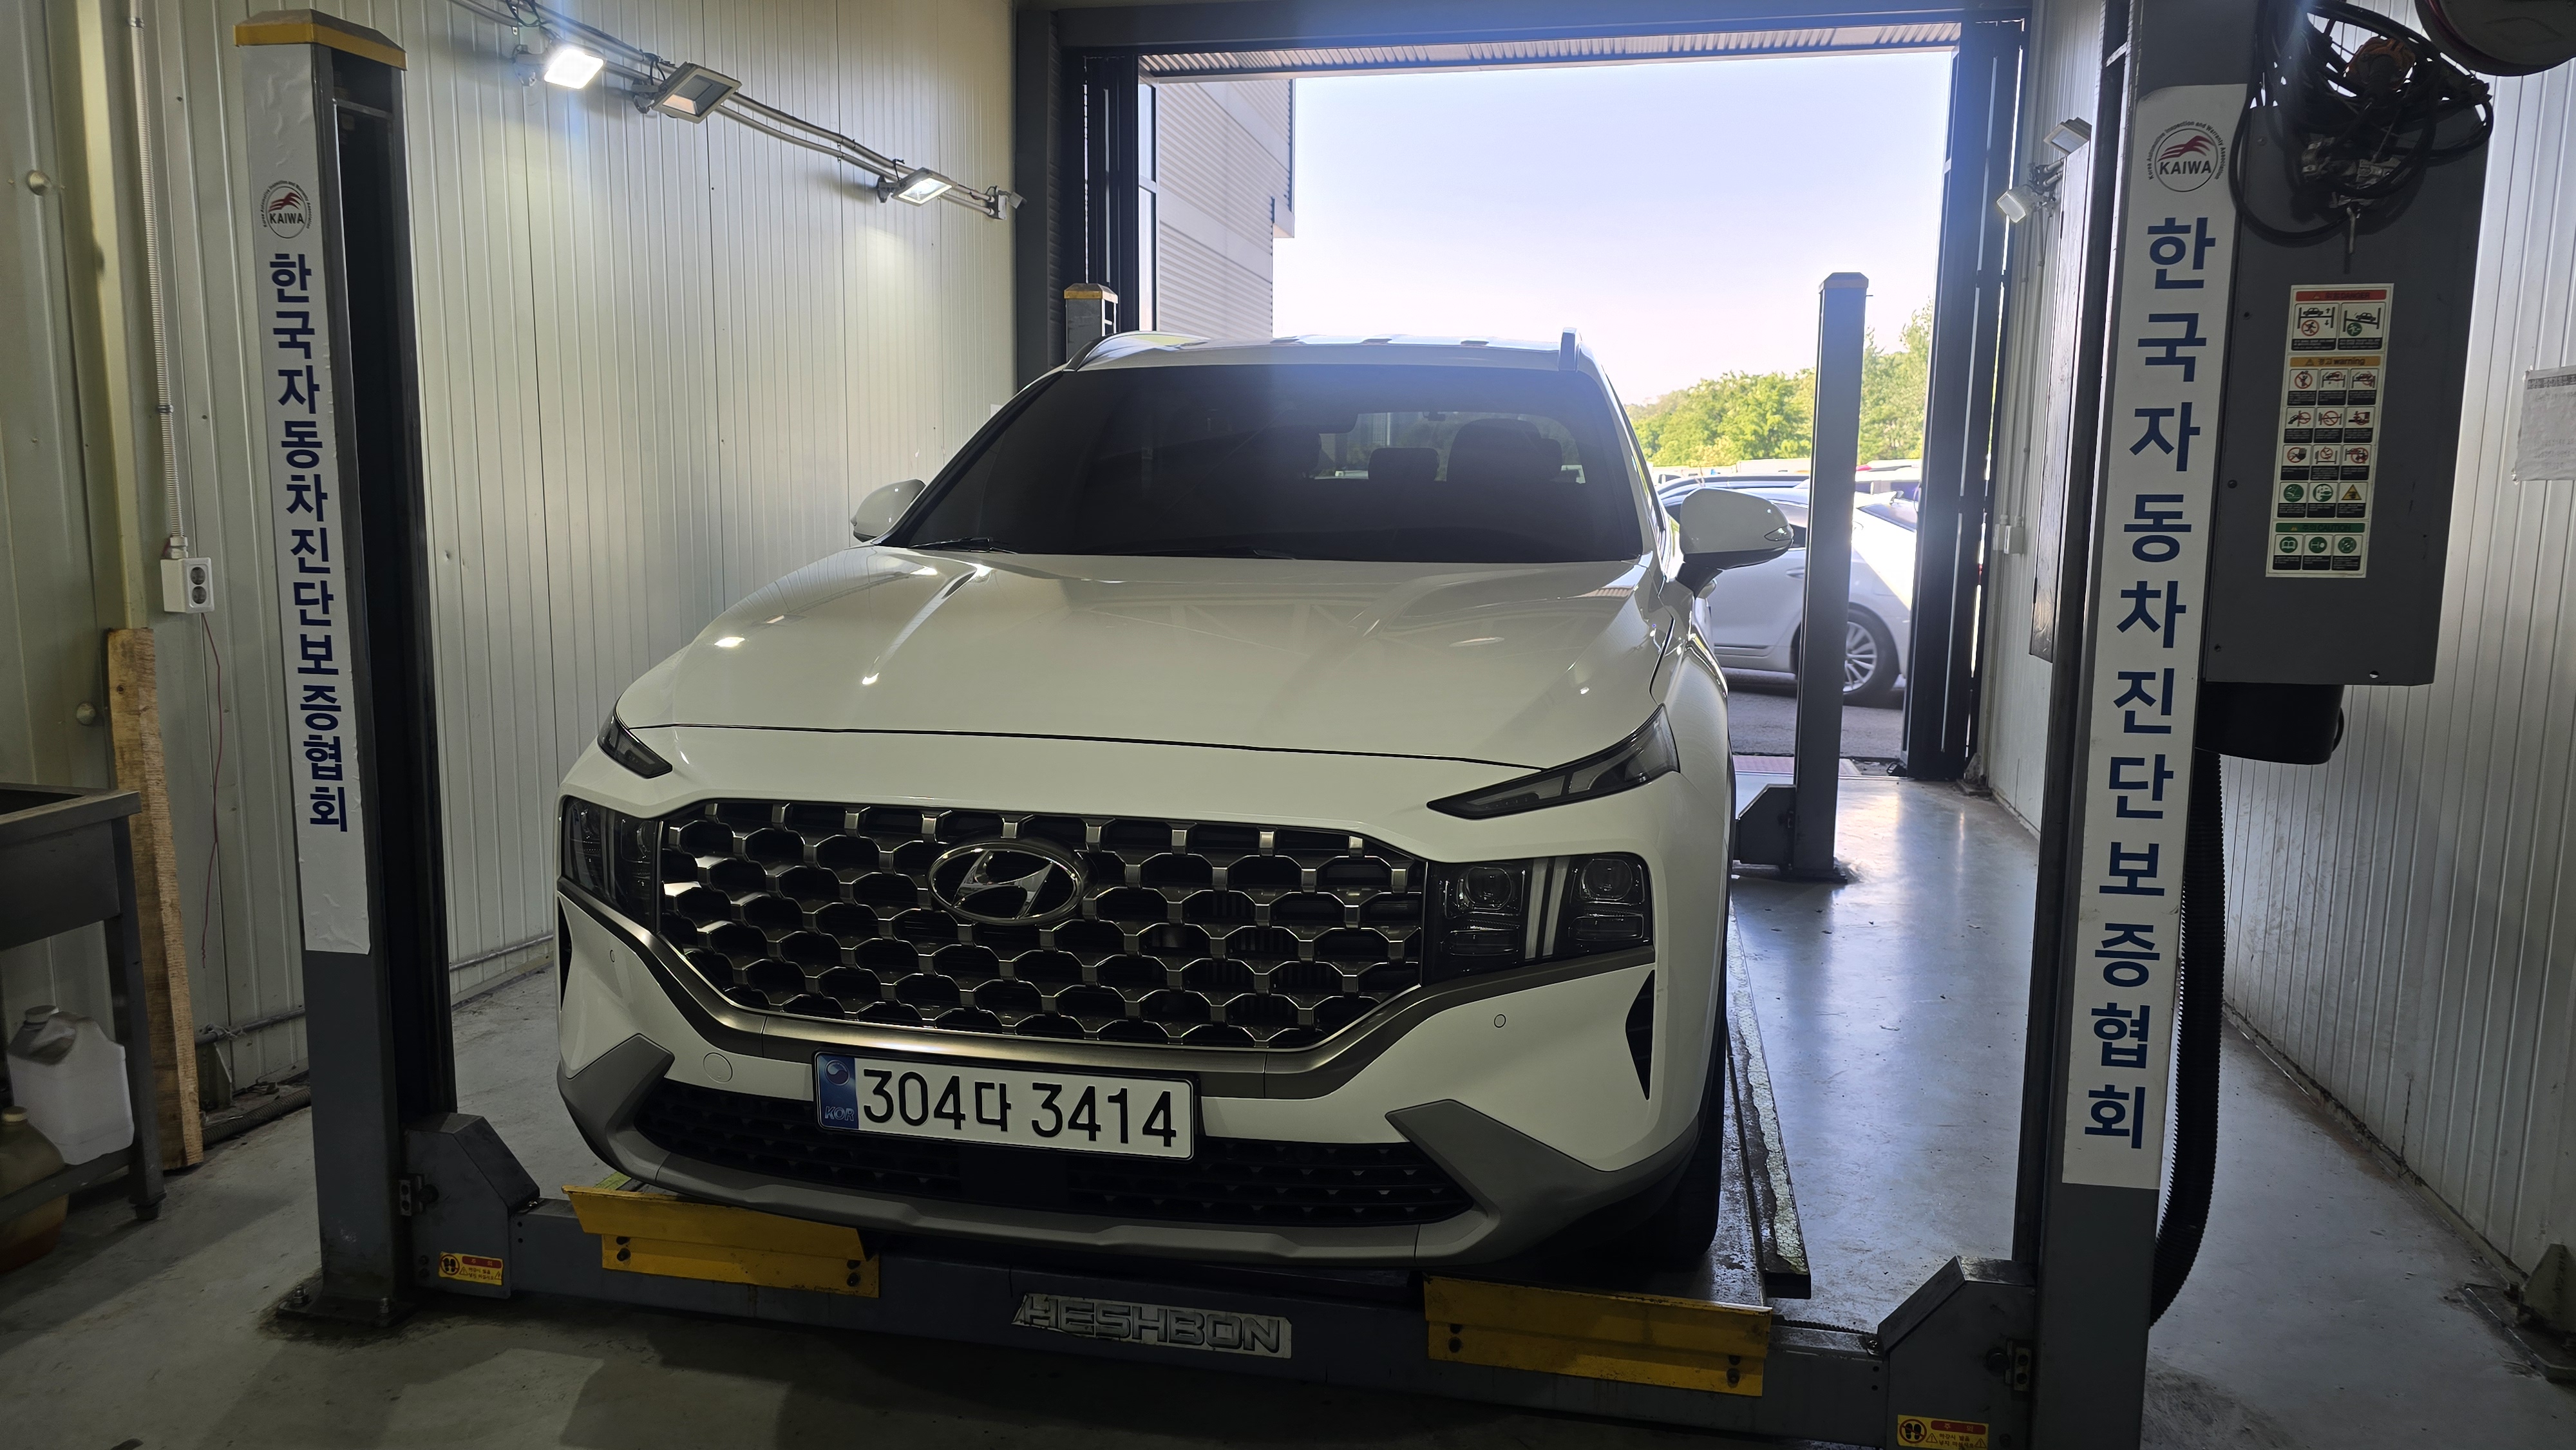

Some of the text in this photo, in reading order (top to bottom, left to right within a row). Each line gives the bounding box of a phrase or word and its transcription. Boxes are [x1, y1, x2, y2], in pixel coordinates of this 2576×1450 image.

[2206, 125, 2224, 146] Warranty
[2159, 160, 2211, 175] KAIWA
[269, 212, 305, 224] KAIWA
[2333, 357, 2365, 366] warning
[269, 253, 348, 832] 한국자동차진단보증협회
[2085, 216, 2216, 1149] 한국자동차진단보증협회
[825, 1106, 855, 1122] KOR
[863, 1069, 1177, 1147] 304다 3414
[1023, 1294, 1280, 1354] HESHBON
